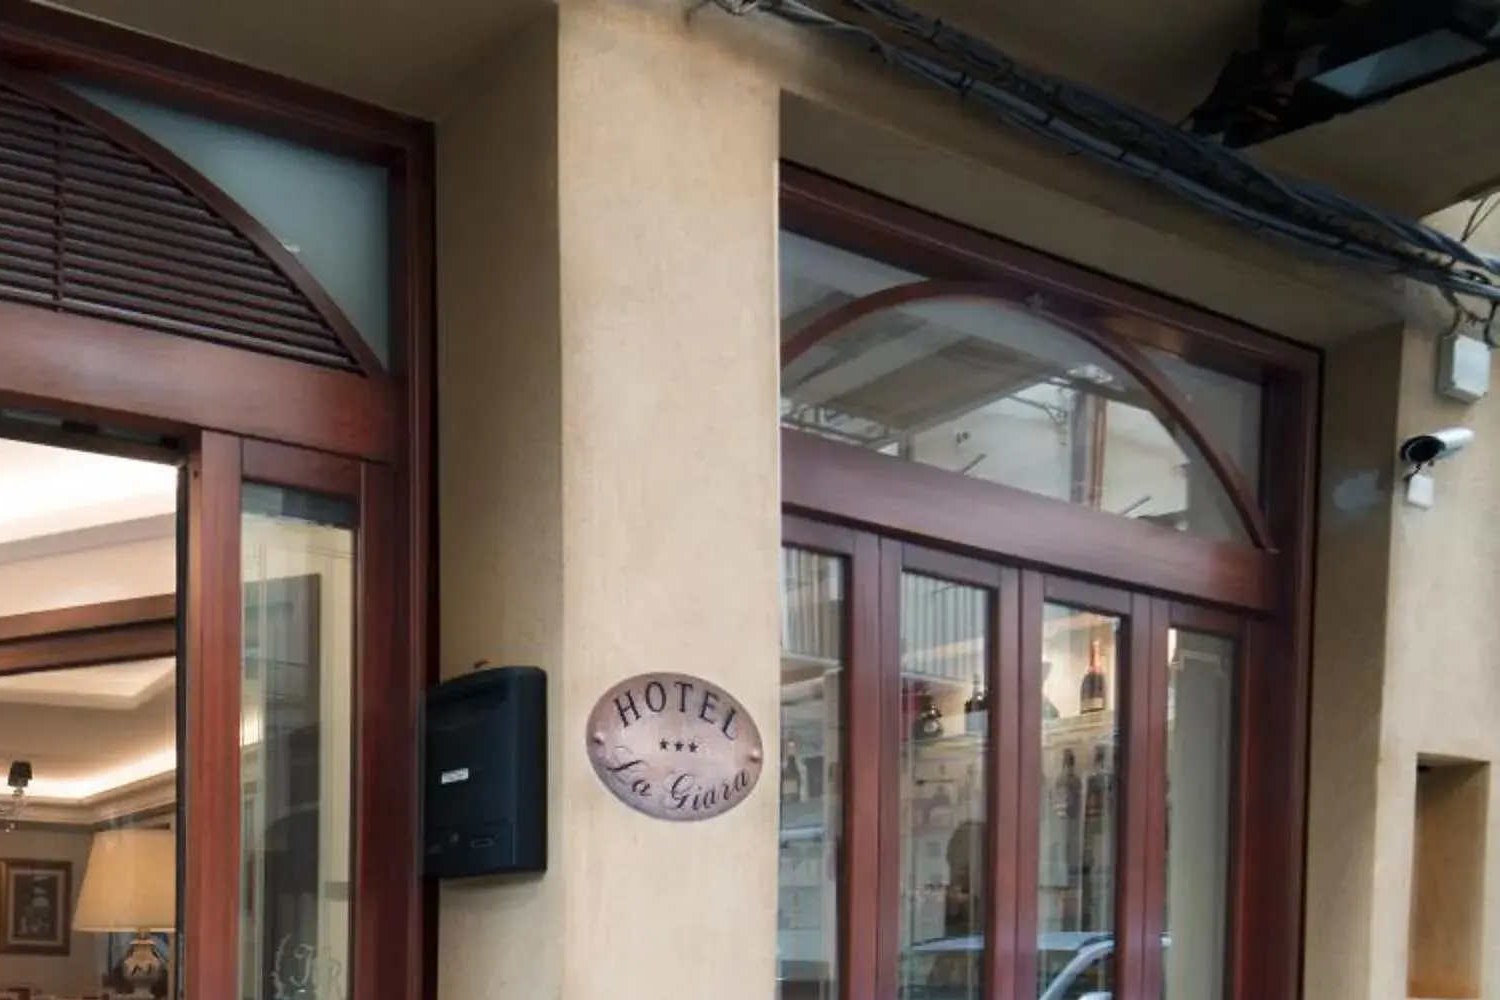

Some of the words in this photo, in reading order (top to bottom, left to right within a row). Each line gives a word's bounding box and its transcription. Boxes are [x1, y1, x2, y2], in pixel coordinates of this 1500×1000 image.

[613, 681, 739, 742] HOTEL
[604, 746, 653, 797] La
[667, 771, 749, 812] Giara
